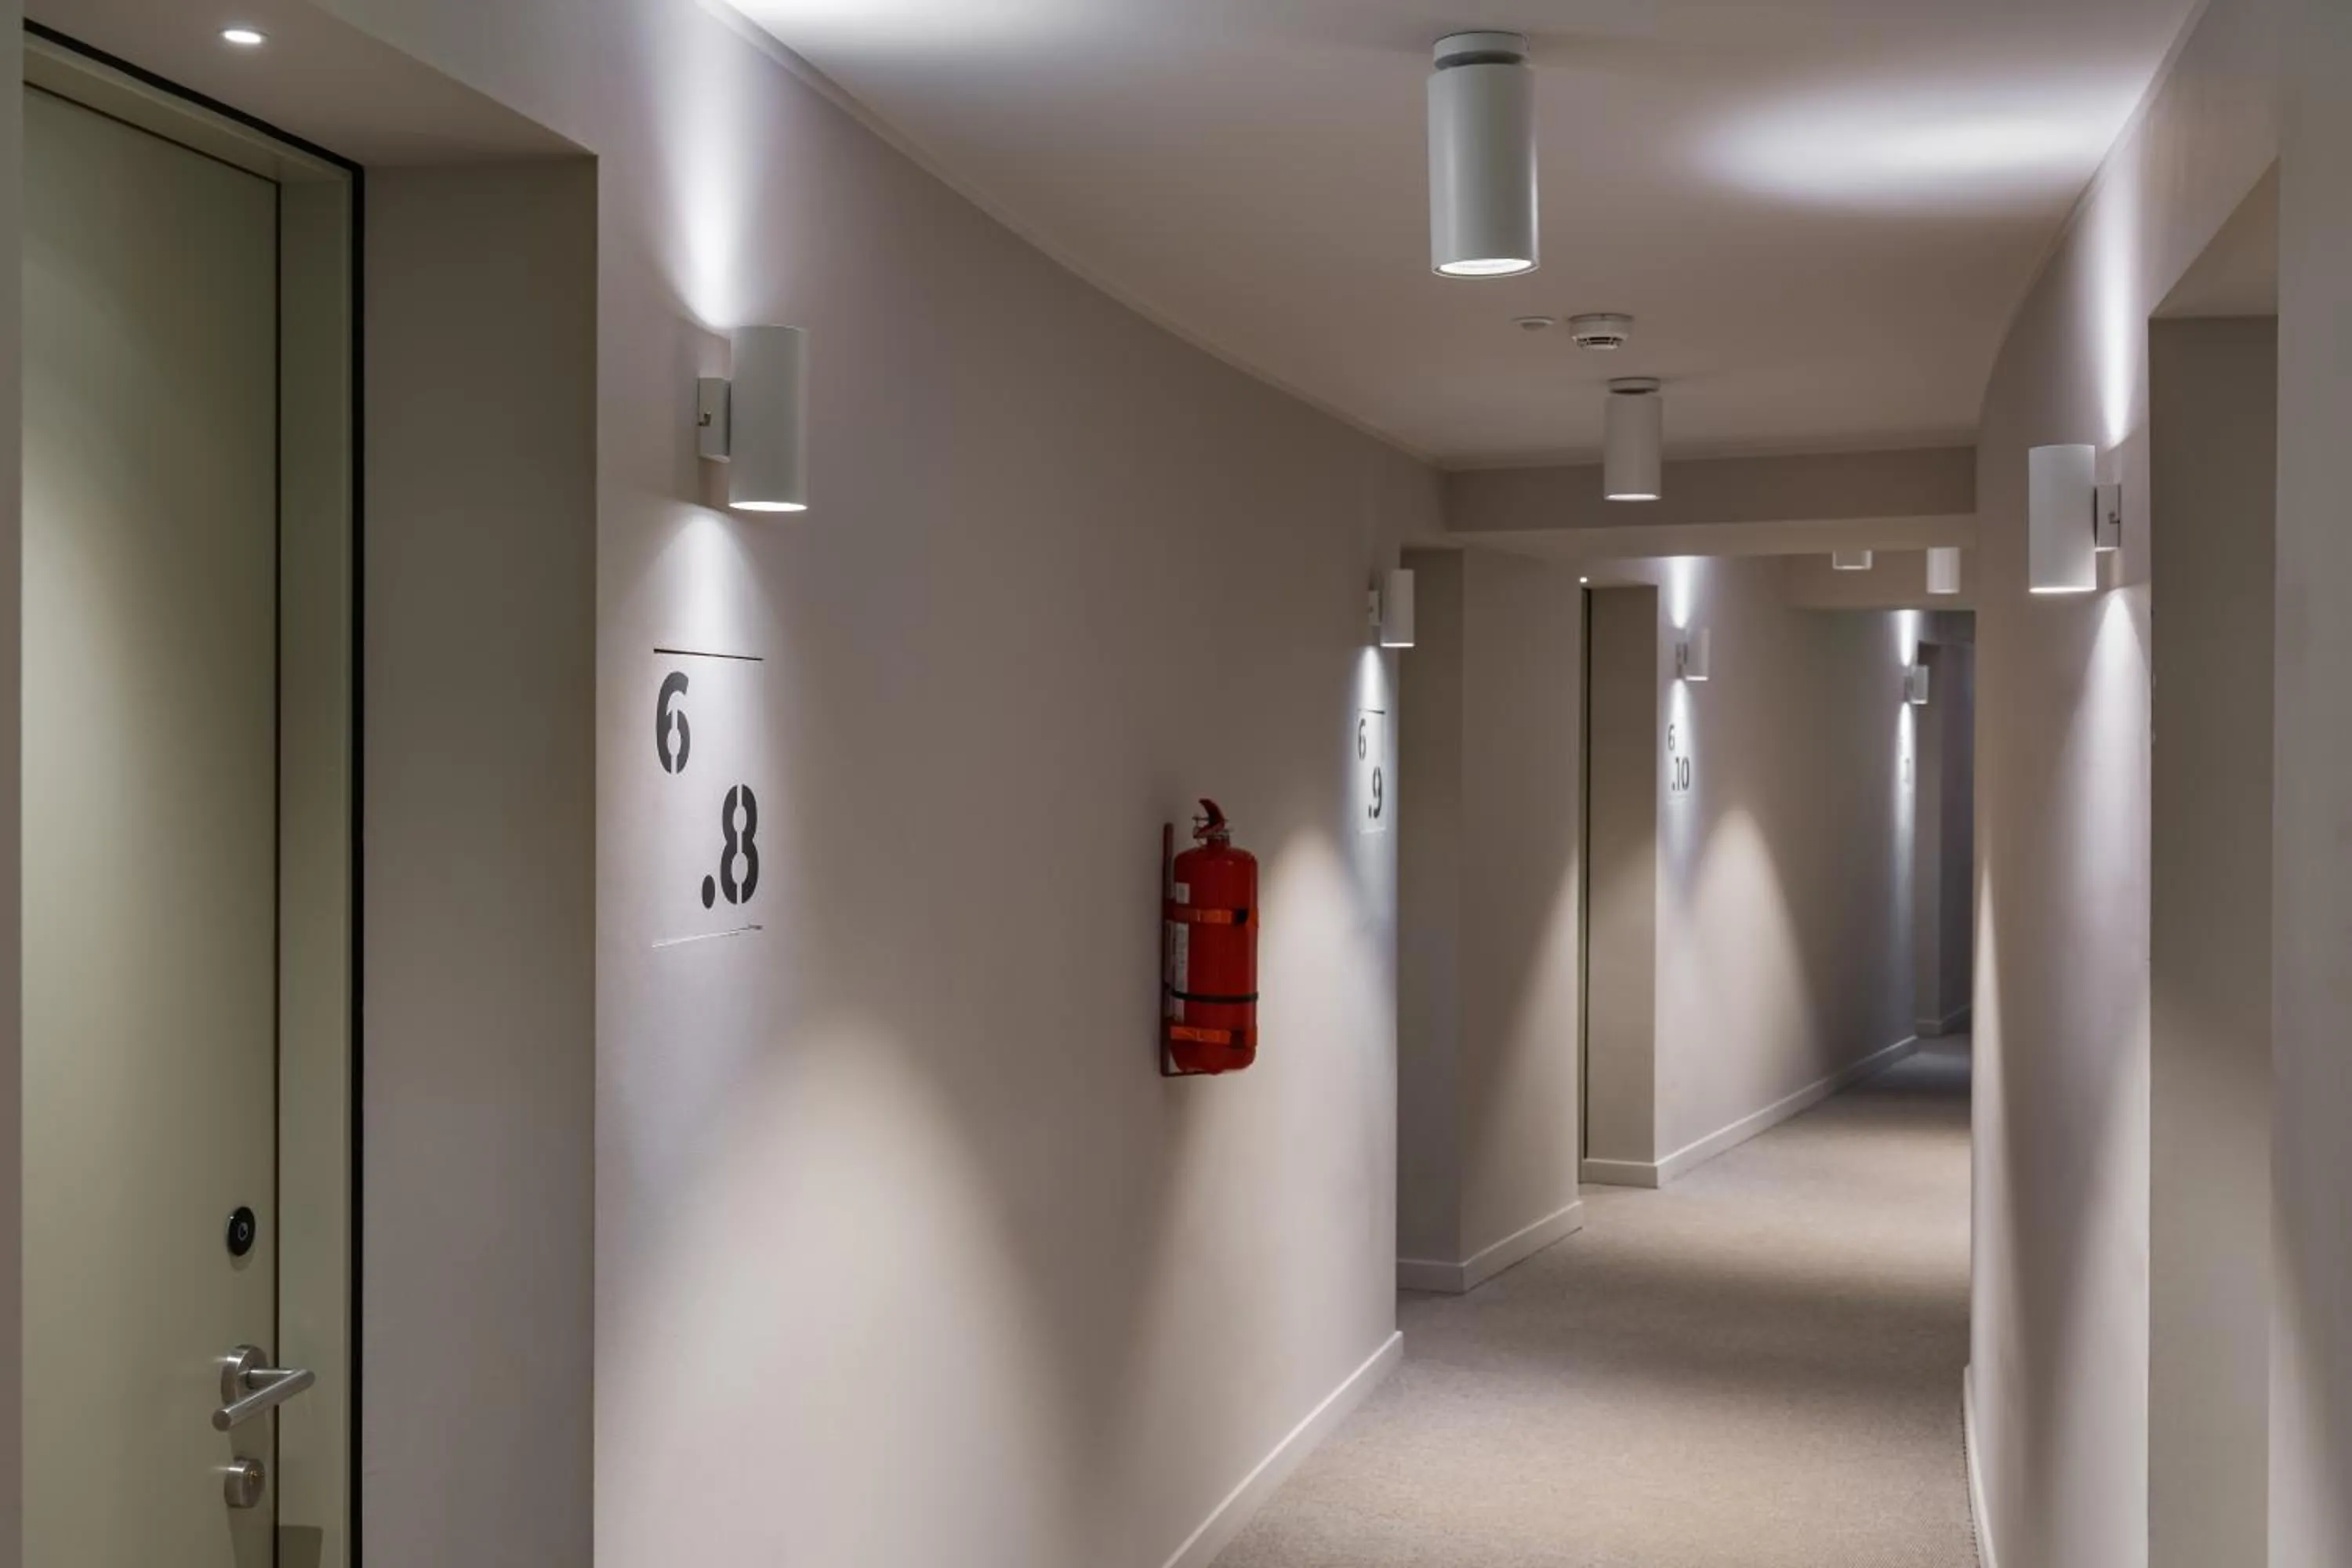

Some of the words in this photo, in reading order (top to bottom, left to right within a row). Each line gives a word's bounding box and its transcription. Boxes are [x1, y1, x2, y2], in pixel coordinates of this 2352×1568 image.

[657, 671, 690, 774] 6
[1359, 718, 1367, 761] 6
[1668, 724, 1675, 750] 6
[702, 785, 759, 908] .8
